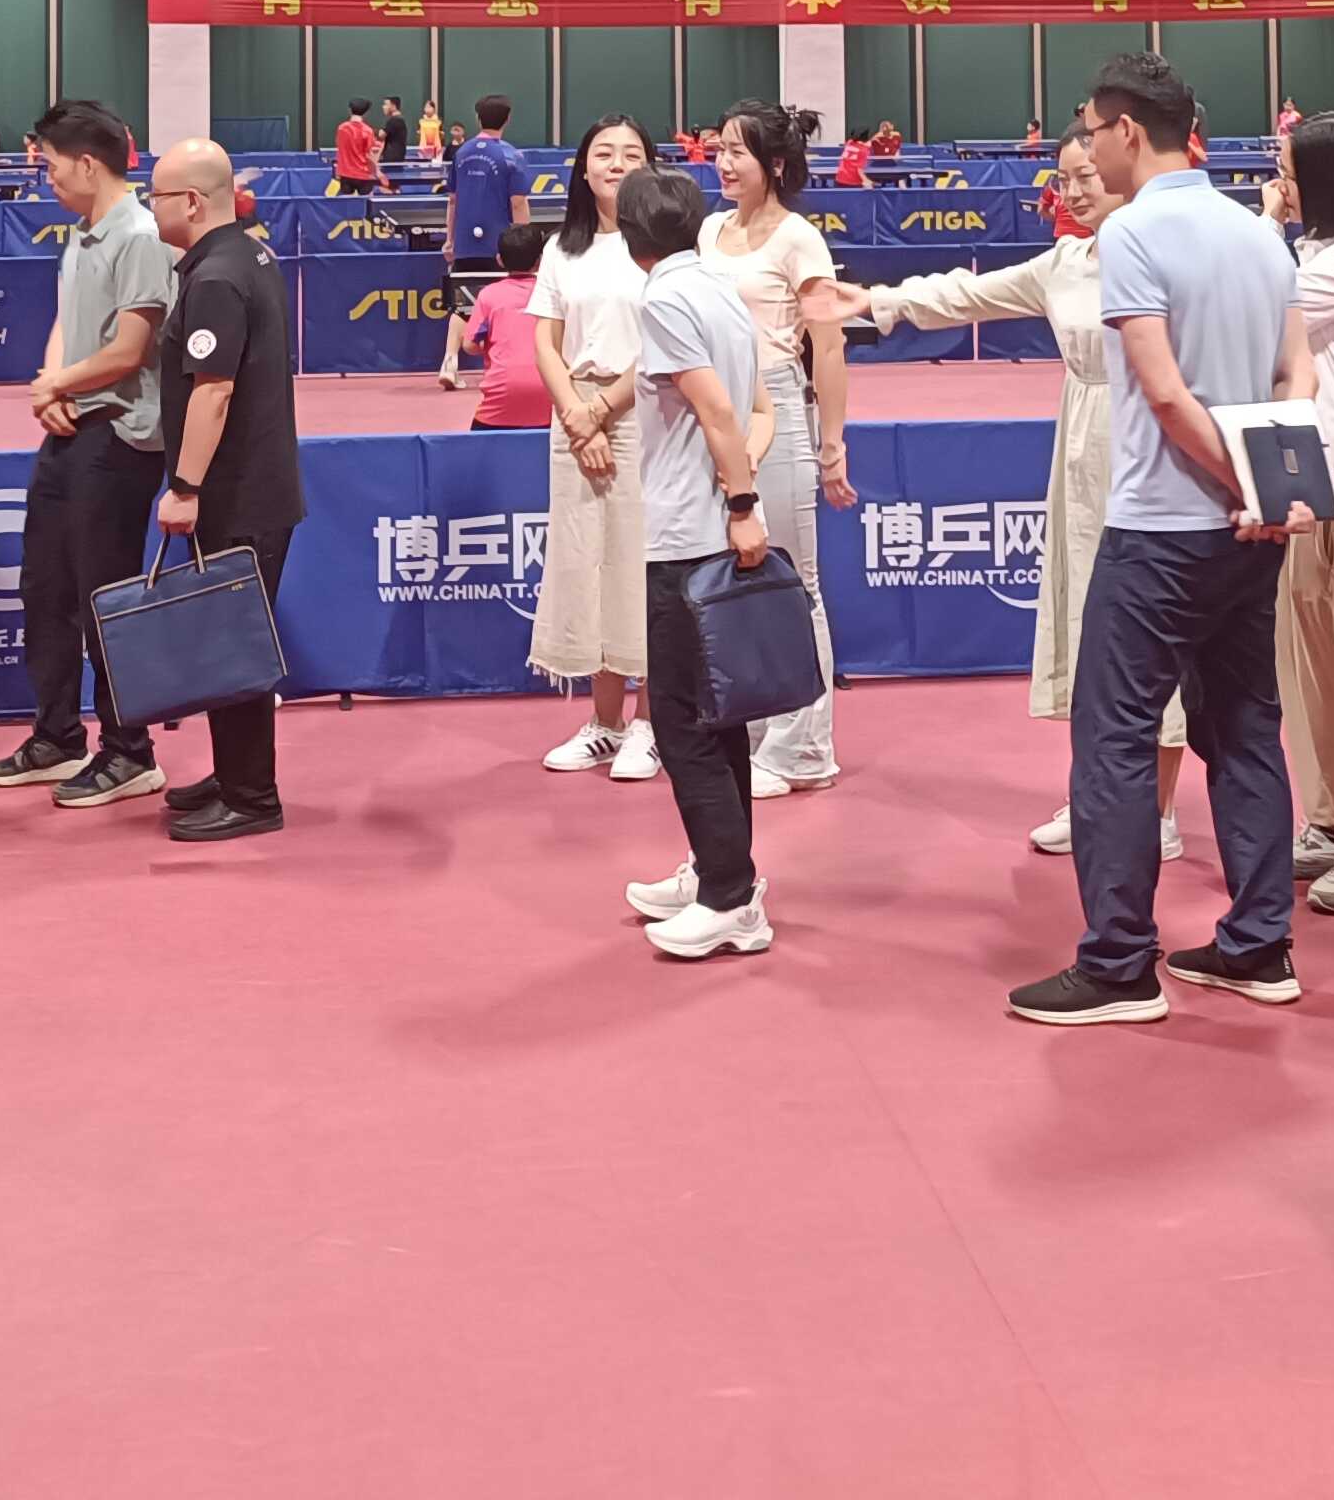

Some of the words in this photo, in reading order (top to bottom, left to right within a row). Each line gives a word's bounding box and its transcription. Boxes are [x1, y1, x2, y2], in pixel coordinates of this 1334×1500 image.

[900, 210, 986, 231] STIGA
[860, 501, 1049, 570] 博乒网
